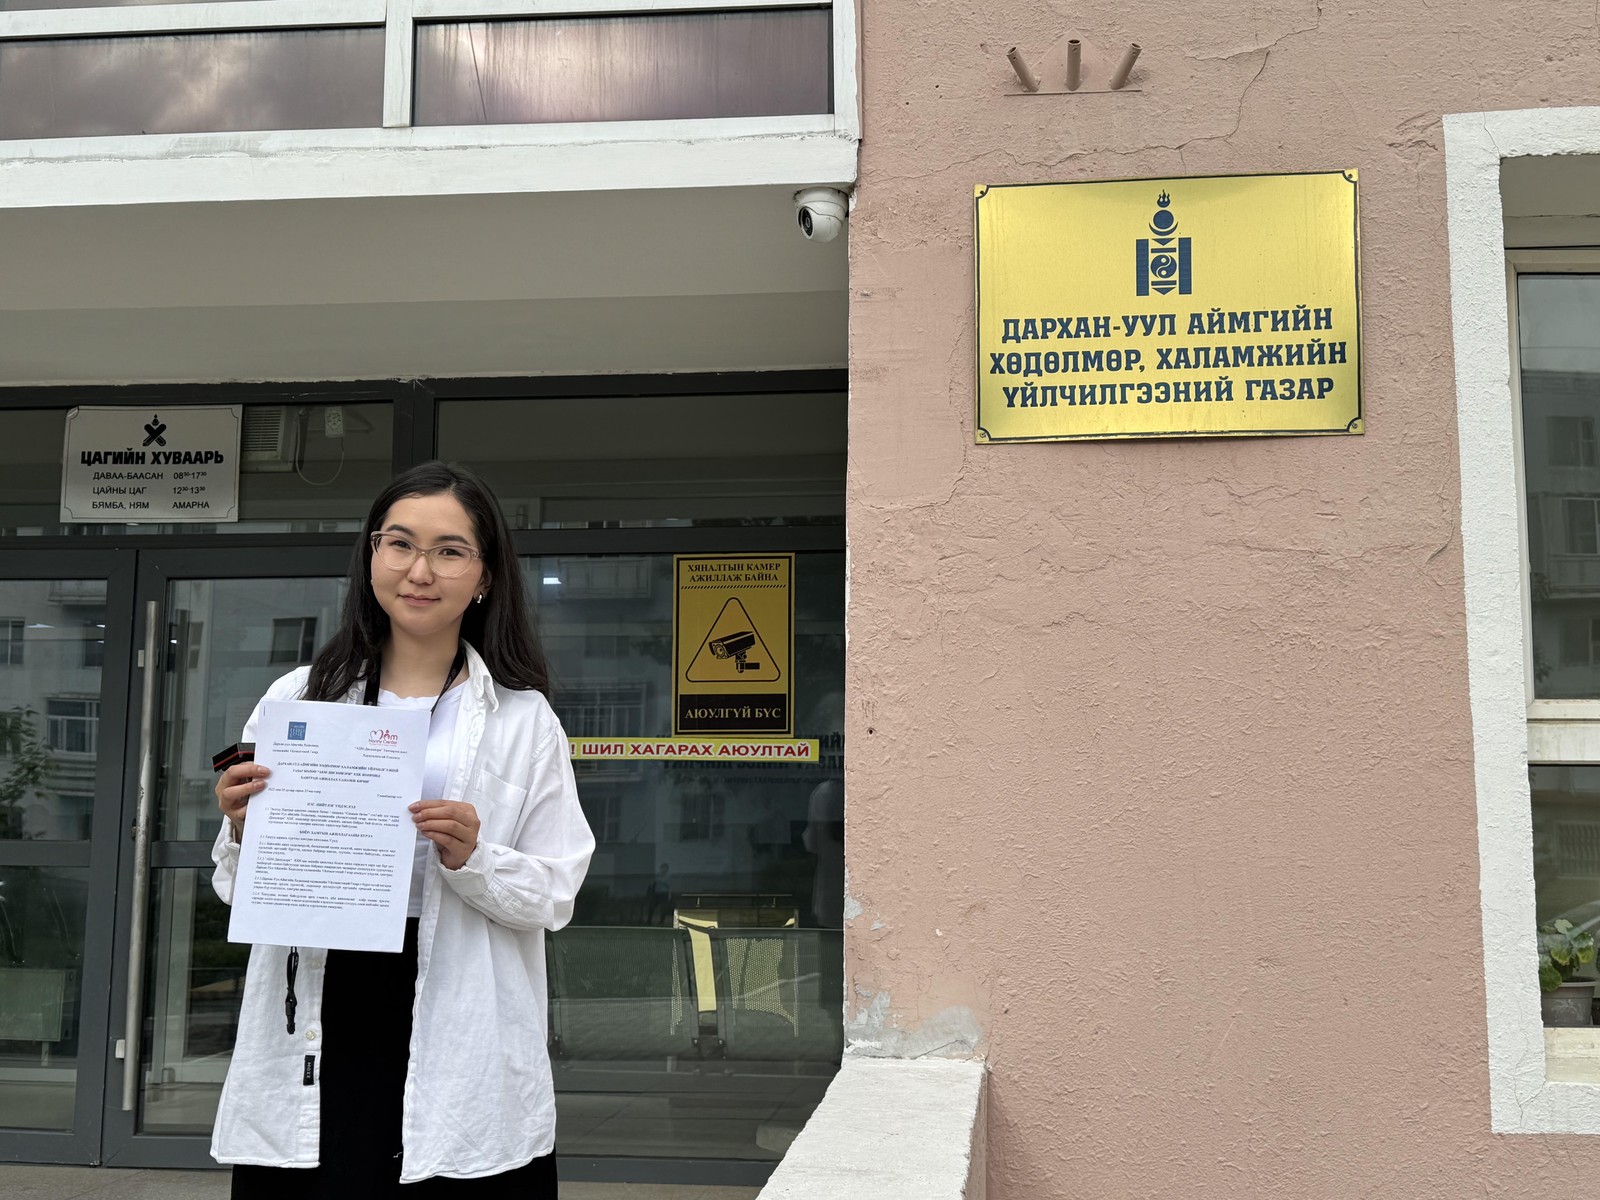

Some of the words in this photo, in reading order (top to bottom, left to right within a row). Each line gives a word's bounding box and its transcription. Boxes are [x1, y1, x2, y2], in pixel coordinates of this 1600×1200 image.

[1002, 314, 1176, 343] ДАРХАН-УУЛ
[1187, 304, 1333, 335] АЙМГИЙН
[989, 348, 1146, 378] ХӨДӨЛМӨР,
[1156, 339, 1347, 370] ХАЛАМЖИЙН
[1002, 376, 1234, 408] ҮЙЛЧИЛГЭЭНИЙ
[1245, 377, 1334, 401] ГАЗАР
[80, 448, 146, 466] ЦАГИЙН
[150, 451, 224, 465] ХУВААРЬ
[92, 472, 164, 480] ДАВАА-БААСАН
[92, 486, 126, 495] ЦАЙНЫ
[129, 487, 147, 495] ЦАГ
[92, 501, 126, 510] БЯМБА,
[129, 501, 150, 509] НЯМ
[172, 501, 210, 509] АМАРНА
[687, 563, 744, 572] ХЯНАЛТЫН
[746, 562, 781, 571] КАМЕР
[689, 573, 742, 582] АЖИЛЛАЖ
[744, 572, 778, 581] БАЙНА
[684, 705, 751, 719] АЮУЛГҮЙ
[754, 706, 781, 719] БҮС
[582, 744, 624, 755] ШИЛ
[630, 744, 713, 756] ХАГАРАХ
[718, 743, 810, 757] АЮУЛТАЙ
